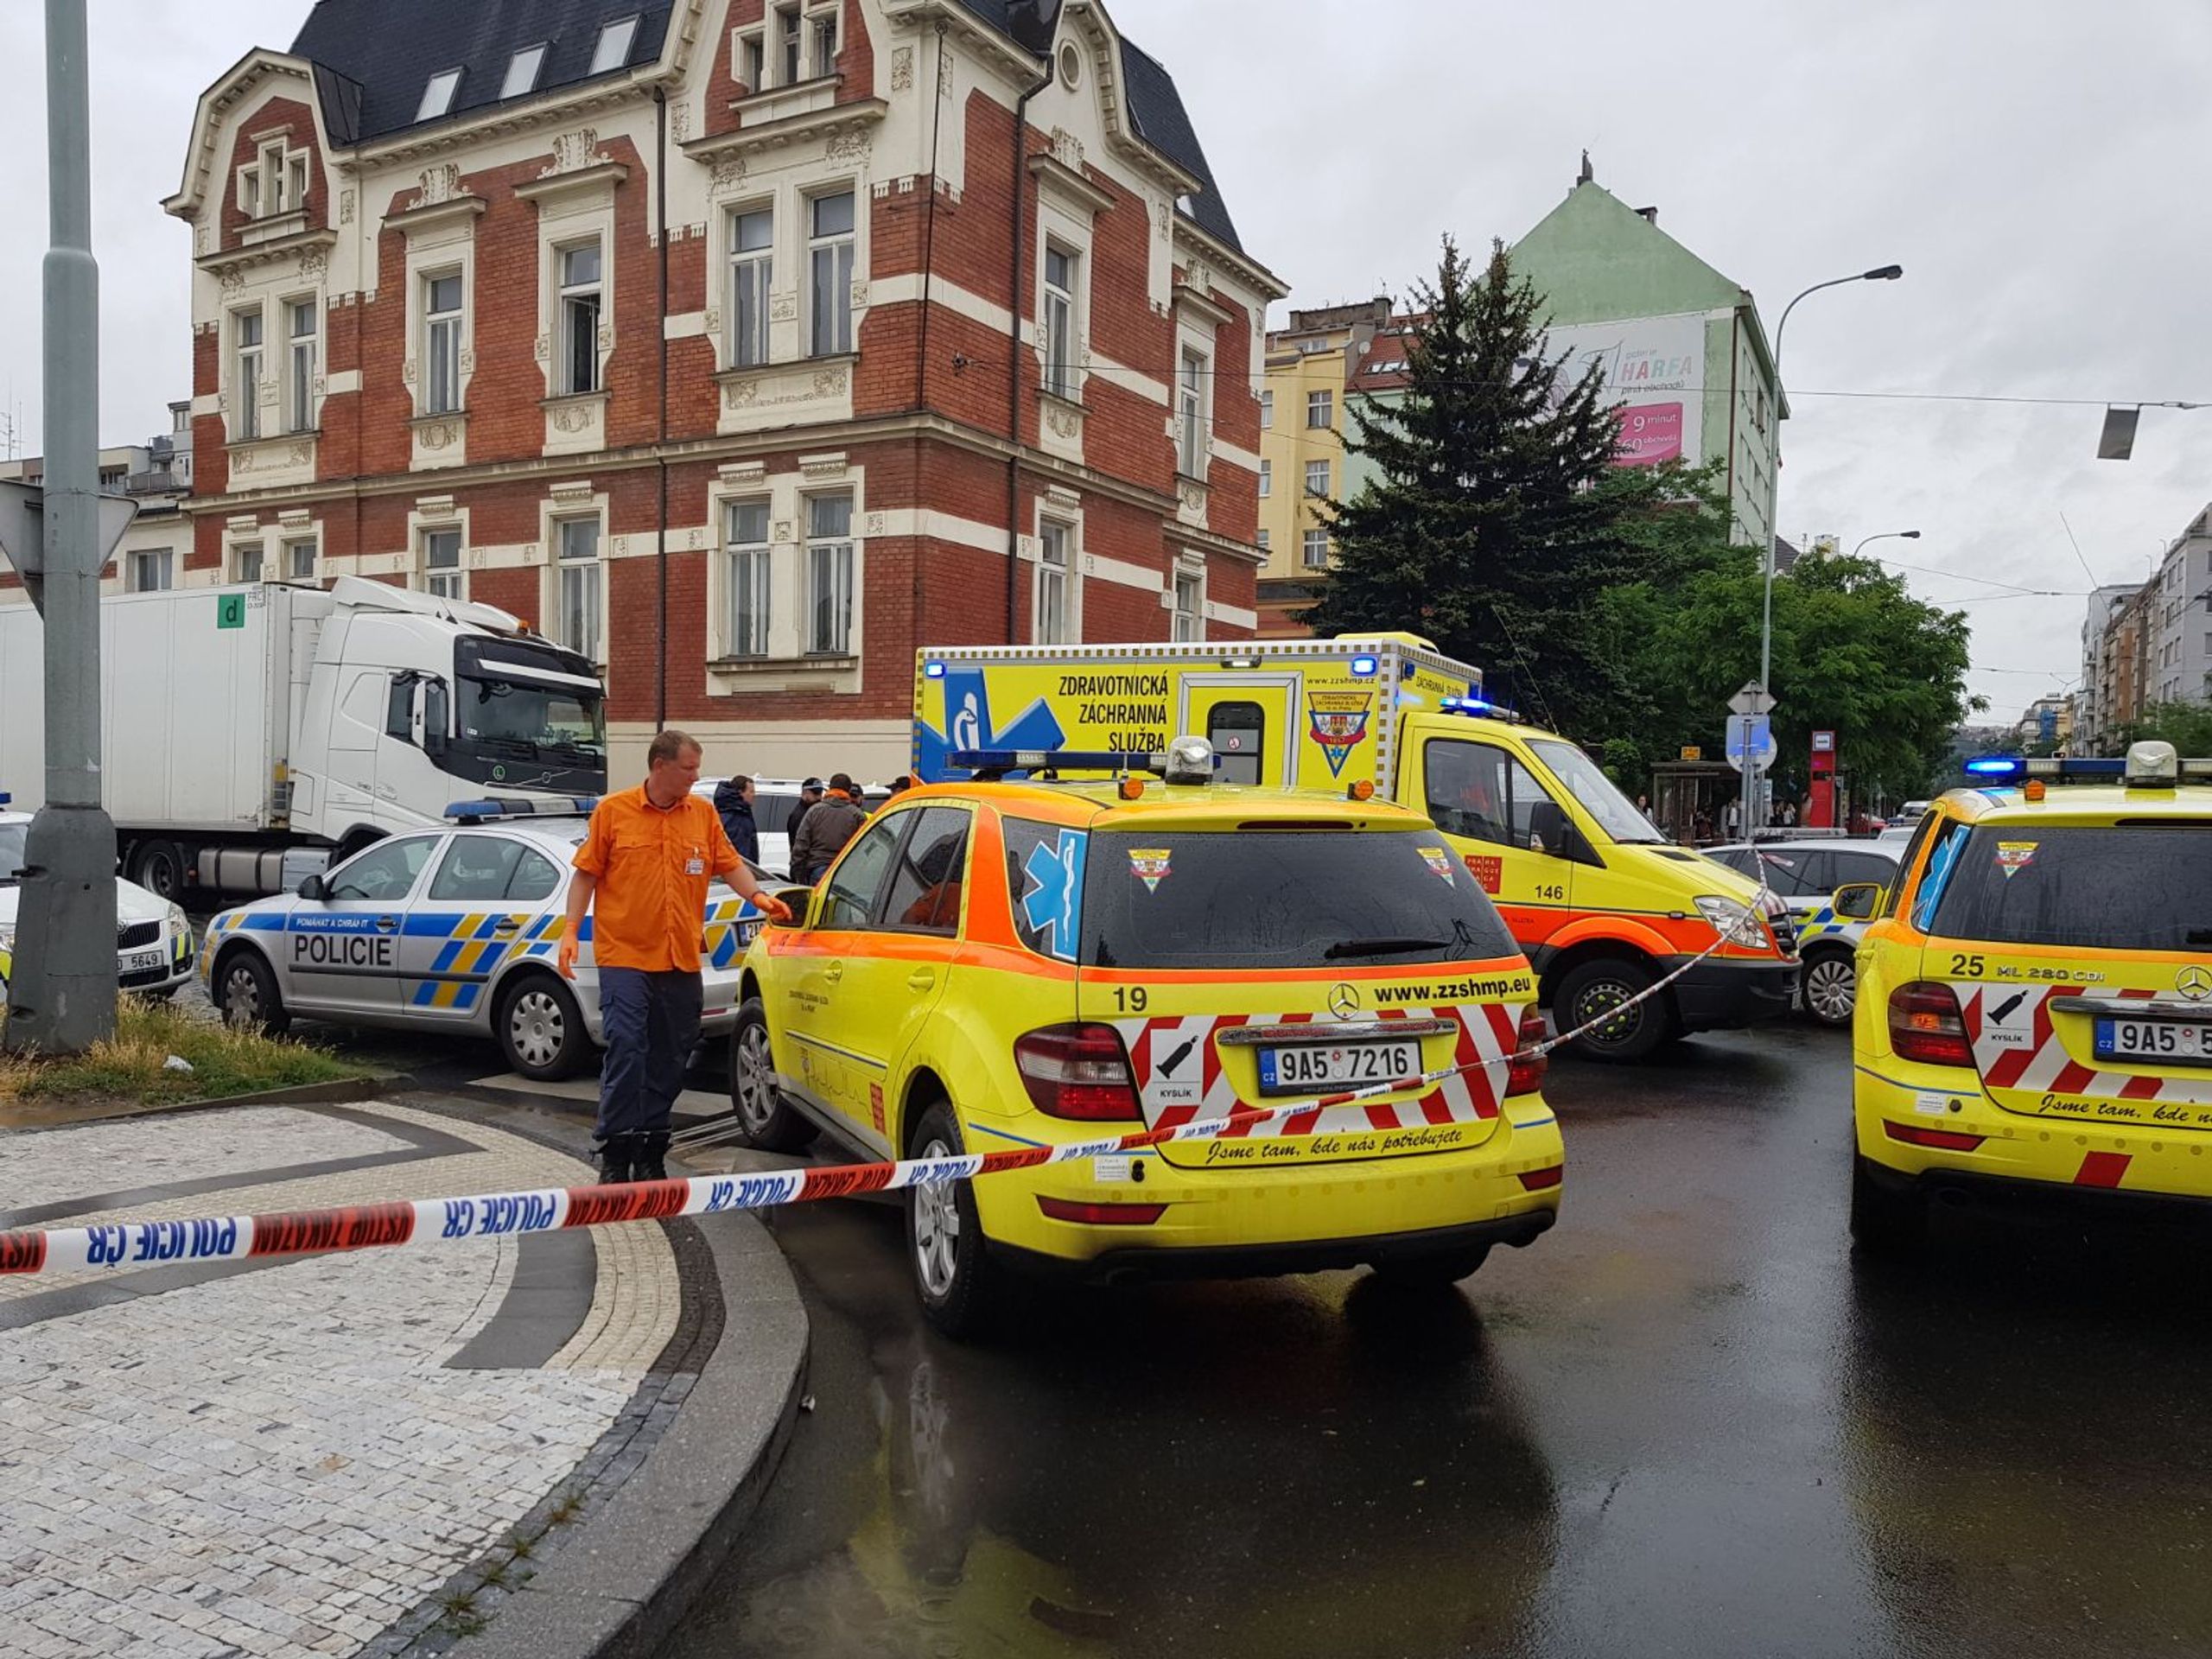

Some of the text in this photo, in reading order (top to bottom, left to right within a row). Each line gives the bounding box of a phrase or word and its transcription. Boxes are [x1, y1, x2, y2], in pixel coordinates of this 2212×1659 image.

[1621, 356, 1692, 381] HARFA
[1633, 414, 1677, 432] 9 minut
[226, 599, 238, 622] d
[1058, 669, 1169, 696] ZDRAVOTNICKÁ
[1078, 698, 1167, 724] ZÁCHRANNÁ
[1108, 727, 1166, 753] SLUŽBA
[1535, 885, 1563, 899] 146
[131, 954, 157, 969] 5649
[295, 934, 391, 966] POLICIE
[1950, 953, 1985, 977] 25
[1997, 966, 2106, 982] ML 280 CDI
[1113, 987, 1147, 1012] 19
[1374, 977, 1531, 1002] www.zzshmp.eu
[1991, 1033, 2024, 1043] KYSLÍK
[2098, 1039, 2113, 1049] CZ
[2122, 1025, 2176, 1052] 9A5
[1281, 1051, 1328, 1081] 9A5
[1347, 1047, 1408, 1078] 7216
[1262, 1072, 1276, 1082] CZ
[1160, 1088, 1192, 1098] KYSLÍK
[2038, 1093, 2090, 1114] Jsme
[2152, 1104, 2189, 1122] kde
[1205, 1141, 1254, 1165] Jsme
[1310, 1136, 1341, 1154] kde
[1347, 1130, 1376, 1152] nás
[1380, 1128, 1464, 1156] potřebujete
[474, 1193, 557, 1236] POLICIE
[131, 1216, 238, 1262] POLICIE
